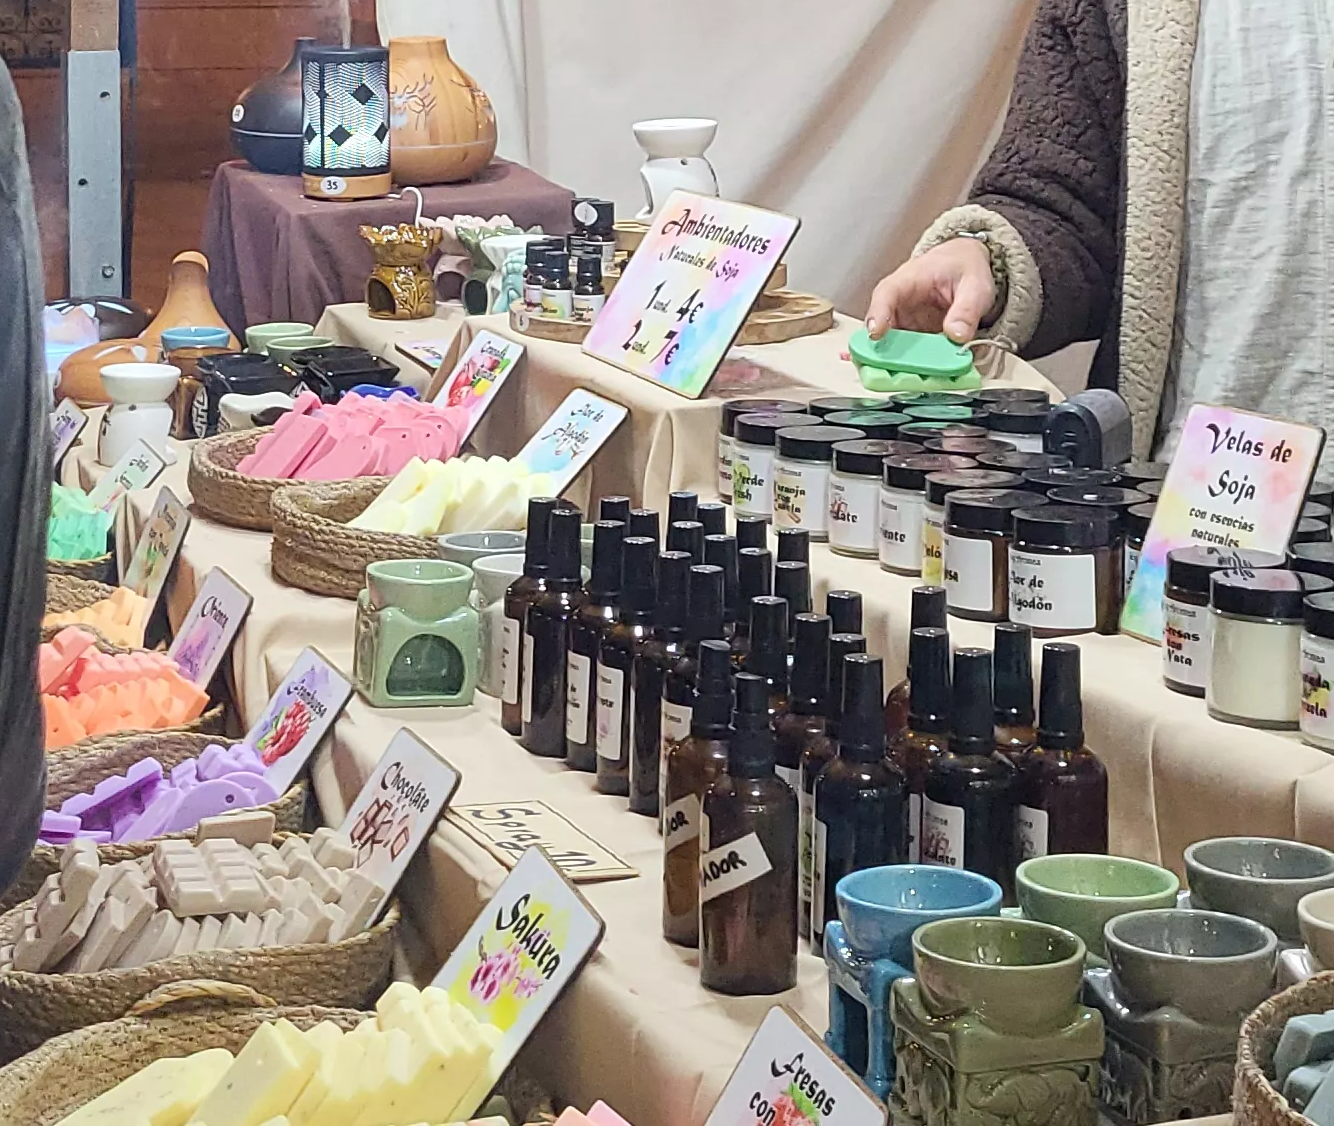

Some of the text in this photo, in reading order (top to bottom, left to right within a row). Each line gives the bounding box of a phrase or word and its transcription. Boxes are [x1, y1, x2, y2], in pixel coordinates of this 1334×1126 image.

[326, 179, 338, 191] 35
[661, 209, 771, 255] Ambientadores
[659, 245, 739, 282] Naturales de Soja
[676, 289, 703, 324] 4€
[650, 330, 679, 366] 7€
[1206, 423, 1293, 463] Velas de
[1208, 470, 1256, 504] Soja
[1189, 507, 1255, 533] con esencias
[1191, 528, 1240, 549] naturales
[1029, 575, 1044, 589] de
[381, 761, 430, 813] Chocolate
[496, 893, 561, 980] Sakura
[771, 1052, 836, 1117] Fresas
[749, 1091, 777, 1126] con
